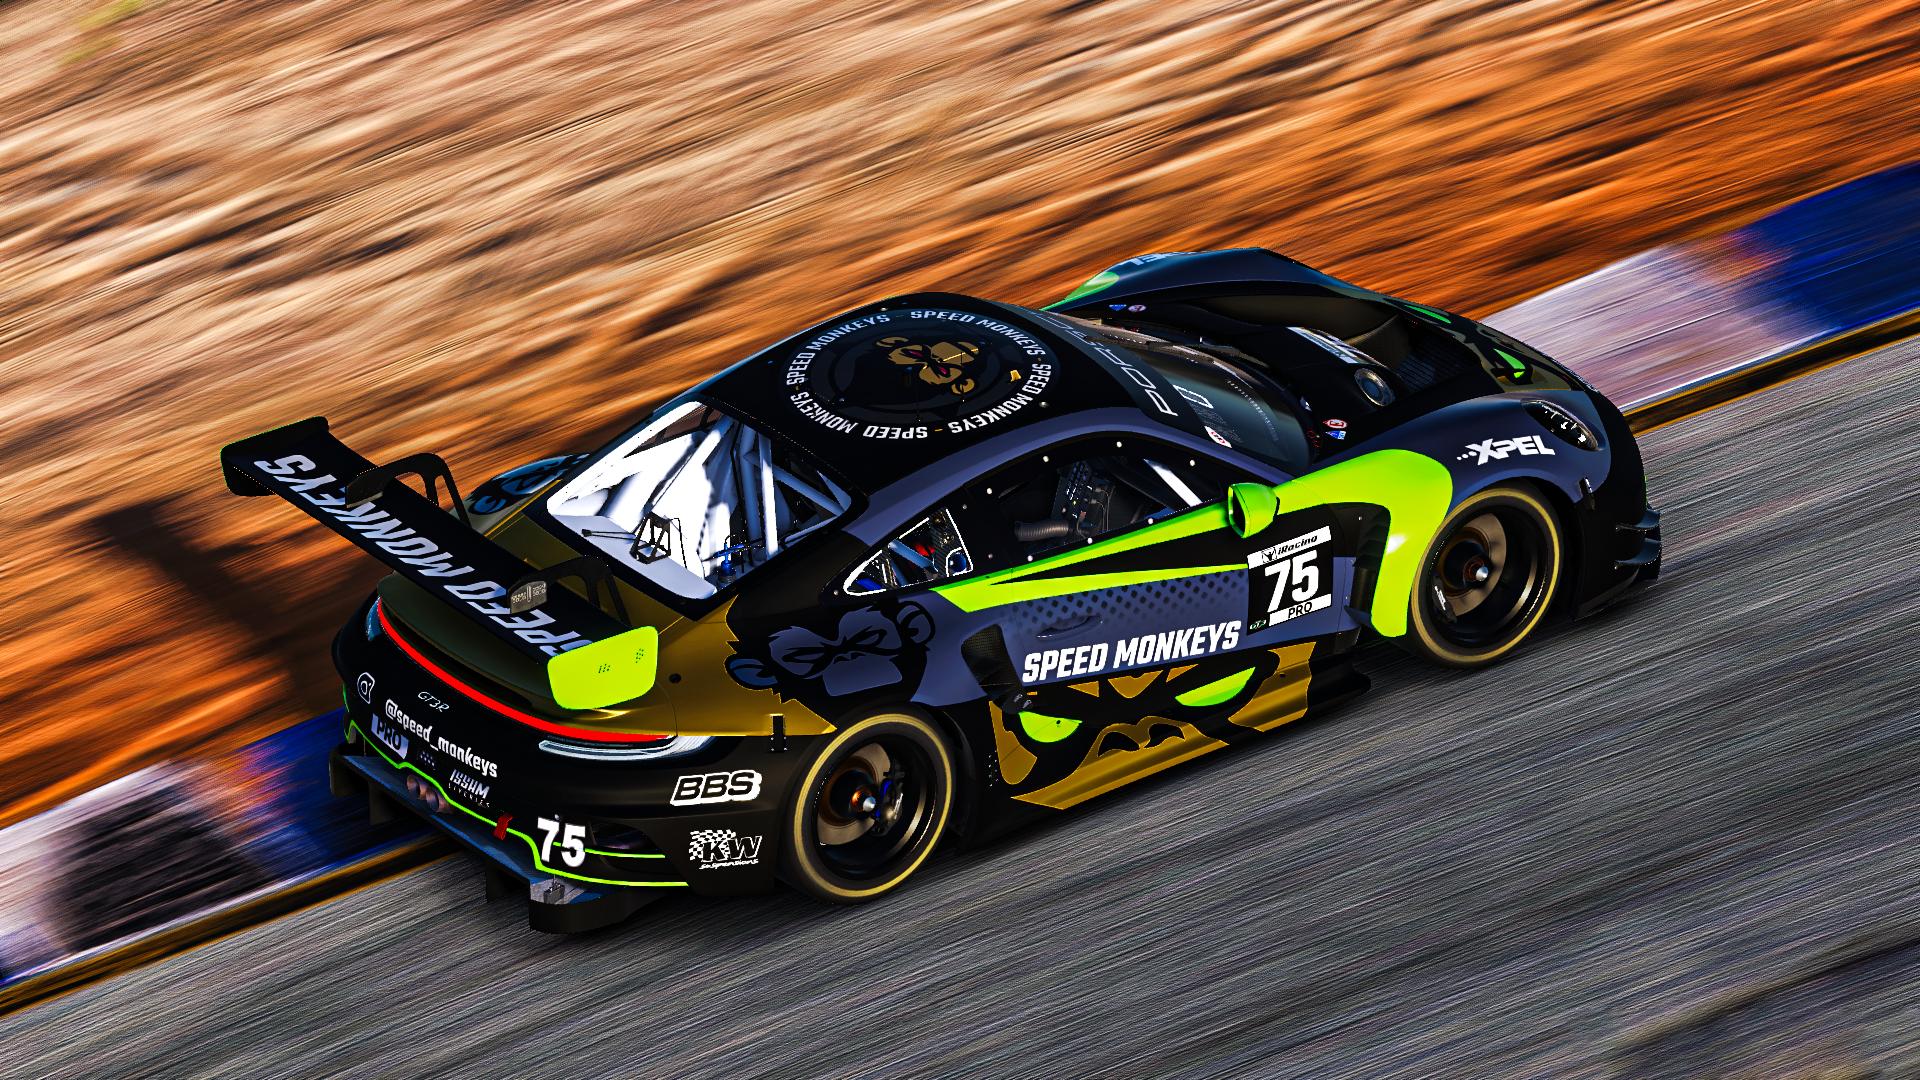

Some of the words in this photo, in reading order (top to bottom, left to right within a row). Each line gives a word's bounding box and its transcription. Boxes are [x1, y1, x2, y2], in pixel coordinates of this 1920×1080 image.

[786, 352, 816, 386] SPEED
[806, 314, 891, 350] MONKEYS
[910, 311, 976, 323] SPEED
[976, 319, 1046, 356] MONKEYS
[1021, 363, 1052, 395] SPEED
[790, 391, 859, 434] MONKEYS
[948, 392, 1034, 434] MONKEYS
[862, 425, 928, 439] SPEED
[1464, 435, 1555, 465] XPEL
[1278, 535, 1318, 555] iRacing
[1264, 549, 1319, 613] 75
[1287, 602, 1313, 619] PRO
[1022, 643, 1107, 683] SPEED
[1112, 620, 1242, 669] MONKEYS
[418, 691, 450, 713] GT3R
[376, 718, 404, 751] PRO
[385, 699, 498, 778] @speed_monkeys
[672, 771, 758, 803] BBS
[537, 816, 586, 867] 75
[701, 835, 763, 862] KW
